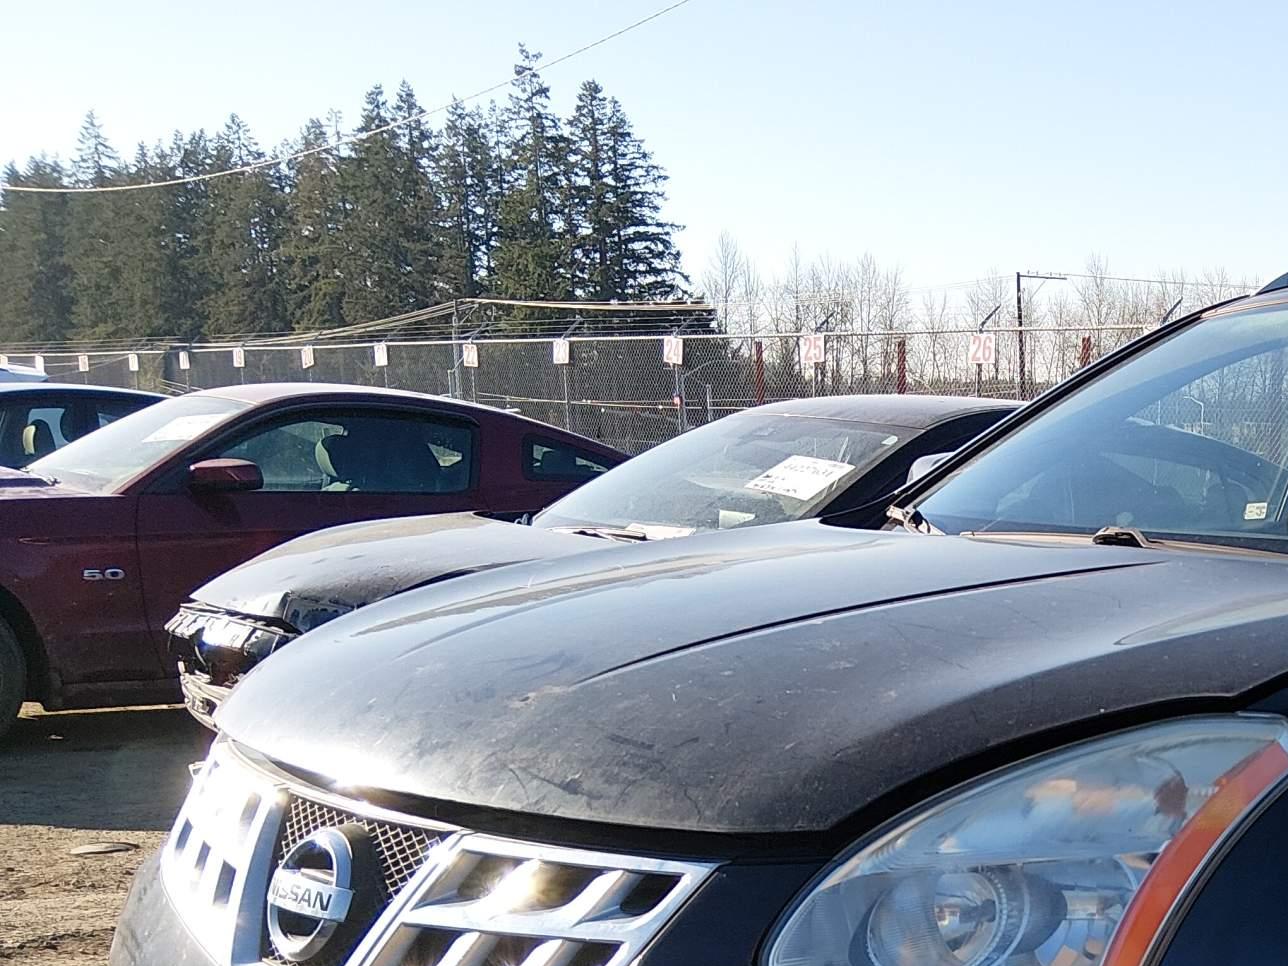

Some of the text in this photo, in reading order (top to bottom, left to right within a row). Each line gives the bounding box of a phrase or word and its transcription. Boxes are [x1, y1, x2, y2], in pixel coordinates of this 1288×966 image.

[665, 338, 681, 363] 24
[803, 337, 822, 361] 25
[971, 336, 993, 361] 26
[271, 878, 332, 911] NISSAN
